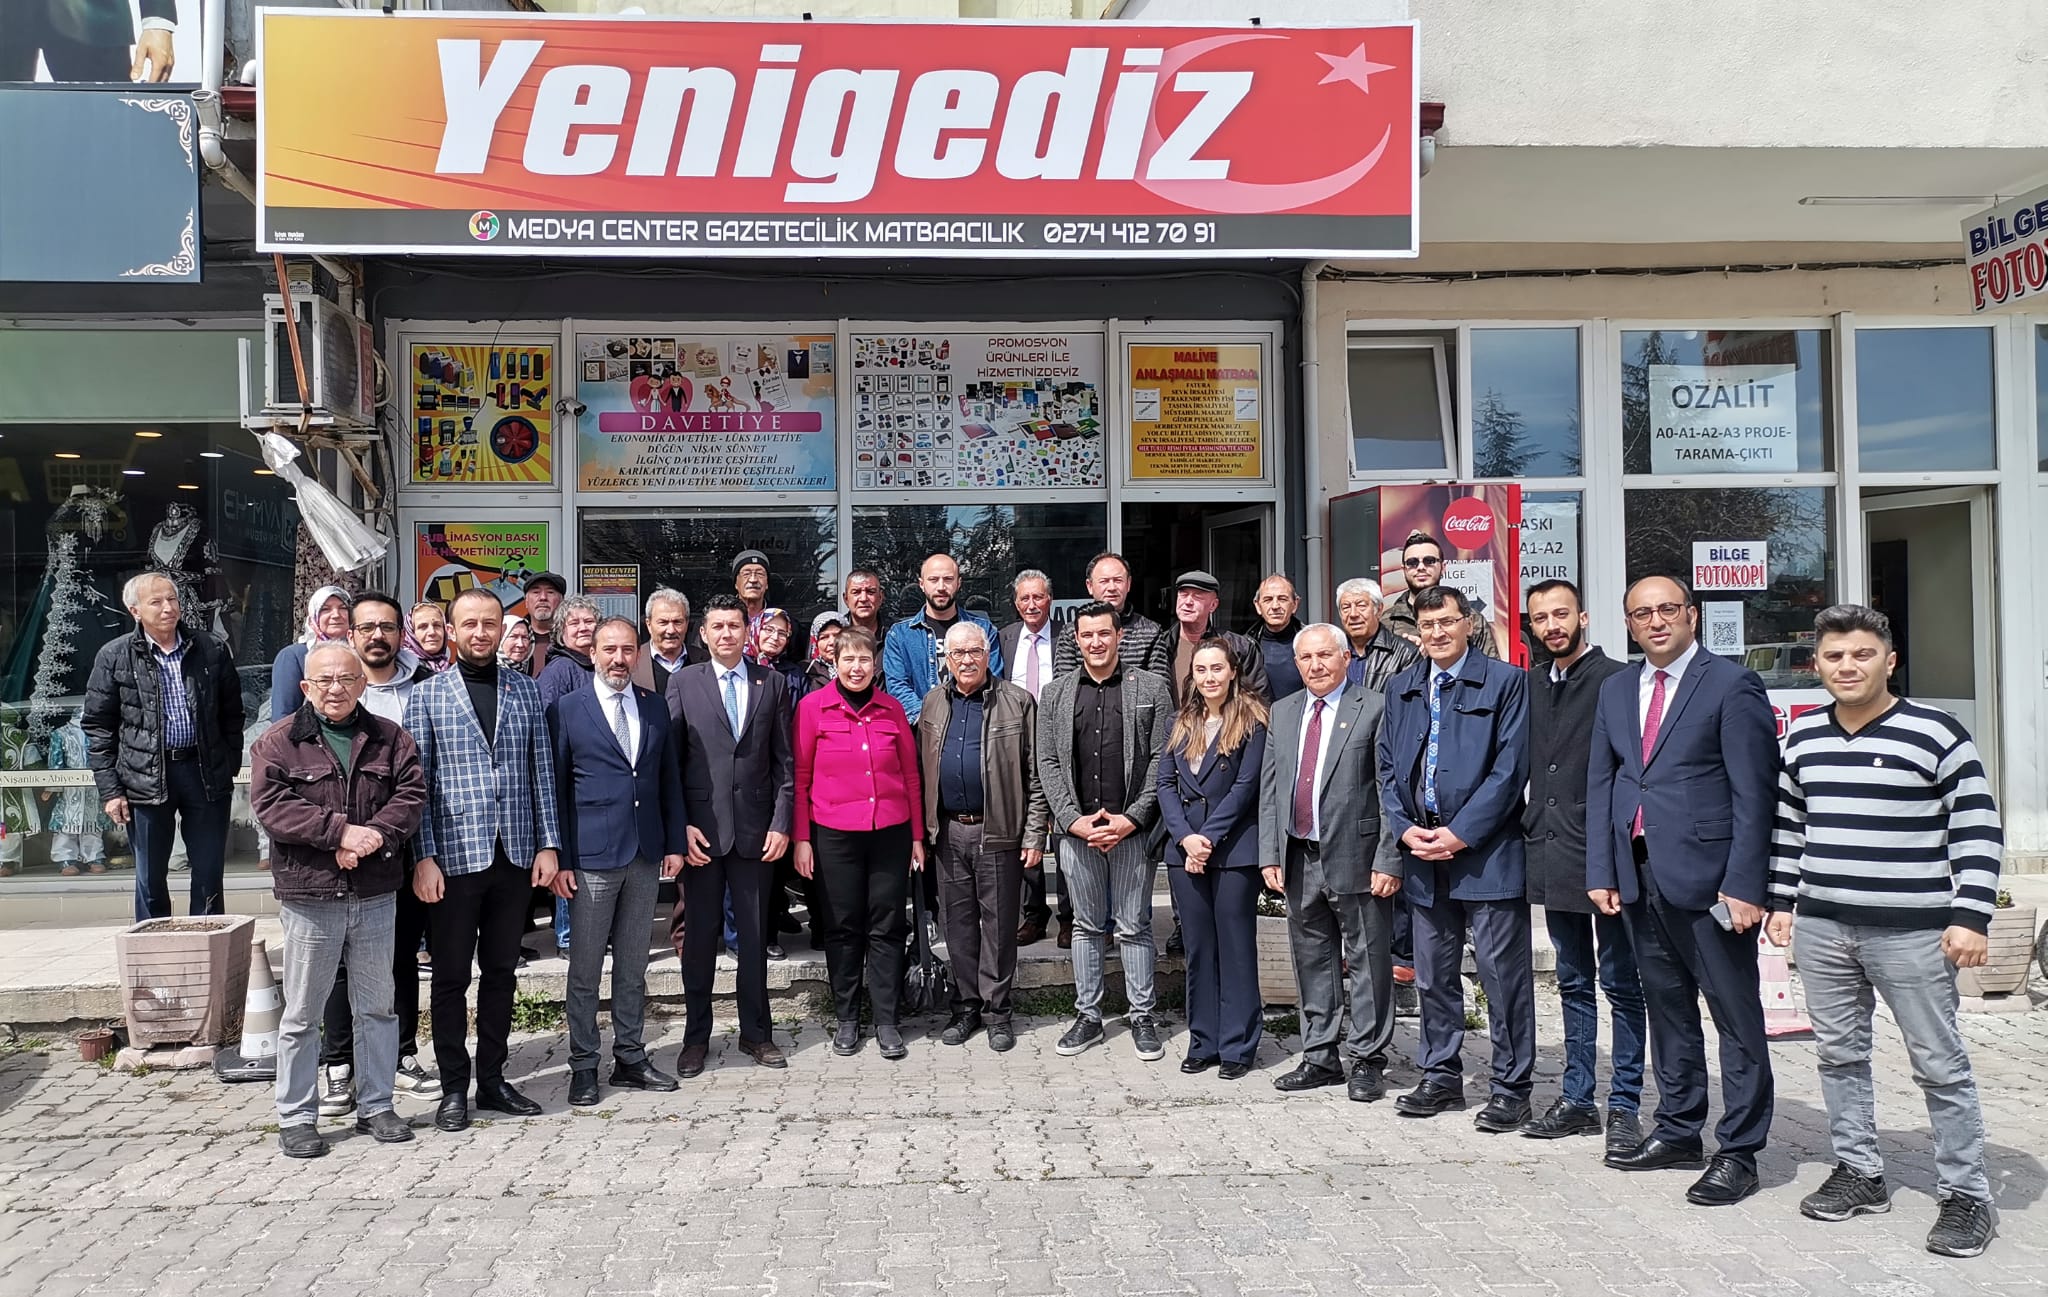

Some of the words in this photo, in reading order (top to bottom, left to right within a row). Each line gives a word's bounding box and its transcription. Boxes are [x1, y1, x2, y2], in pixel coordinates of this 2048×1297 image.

[434, 38, 1254, 203] Yenigediz
[508, 218, 594, 240] MEDYA
[602, 219, 698, 241] CENTER
[706, 217, 859, 243] GAZETECİLİK
[865, 221, 1025, 244] MATBAACILIK
[1043, 222, 1105, 244] 0274
[1111, 222, 1150, 244] 412
[1157, 222, 1187, 243] 70
[1193, 222, 1216, 243] 91
[1969, 200, 2048, 257] BİLGE
[1971, 237, 2048, 311] FOTO
[988, 338, 1067, 348] PROMOSYON
[986, 352, 1049, 362] ÜRÜNLERİ
[1051, 352, 1070, 362] İLE
[1174, 349, 1218, 363] MALİYE
[977, 366, 1079, 377] HİZMETİNİZDEYİZ
[1136, 368, 1205, 382] ANLAŞMALI
[1207, 369, 1258, 380] MATBAA
[1671, 378, 1775, 409] OZALİT
[641, 411, 782, 430] DAVETİYE
[610, 433, 666, 442] EKONOMİK
[668, 433, 716, 442] DAVETİYE
[725, 433, 751, 442] LÜKS
[753, 433, 802, 442] DAVETİYE
[1656, 427, 1741, 439] A0-A1-A2-A3
[1745, 426, 1791, 438] PROJE-
[647, 444, 683, 453] DÜĞÜN
[691, 444, 723, 454] NİŞAN
[726, 444, 767, 453] SÜNNET
[1674, 447, 1773, 461] TARAMA-ÇIKTI
[636, 455, 671, 466] İLGİNÇ
[674, 455, 722, 464] DAVETİYE
[725, 455, 778, 466] ÇEŞİTLERİ
[619, 466, 689, 475] KARİKATÜRLÜ
[692, 466, 740, 475] DAVETİYE
[743, 466, 795, 477] ÇEŞİTLERİ
[587, 478, 639, 486] YÜZLERCE
[642, 477, 666, 486] YENİ
[668, 477, 717, 486] DAVETİYE
[719, 478, 755, 486] MODEL
[757, 477, 826, 487] SEÇENEKLERİ
[1520, 518, 1553, 531] ASKI
[421, 531, 502, 542] SUBLİMASYON
[505, 533, 539, 542] BASKI
[421, 545, 437, 556] İLE
[442, 544, 539, 556] HİZMETİNİZDEYİZ
[1709, 545, 1750, 561] BİLGE
[1520, 565, 1567, 579] APILIR
[1695, 560, 1765, 588] FOTOKOPİ
